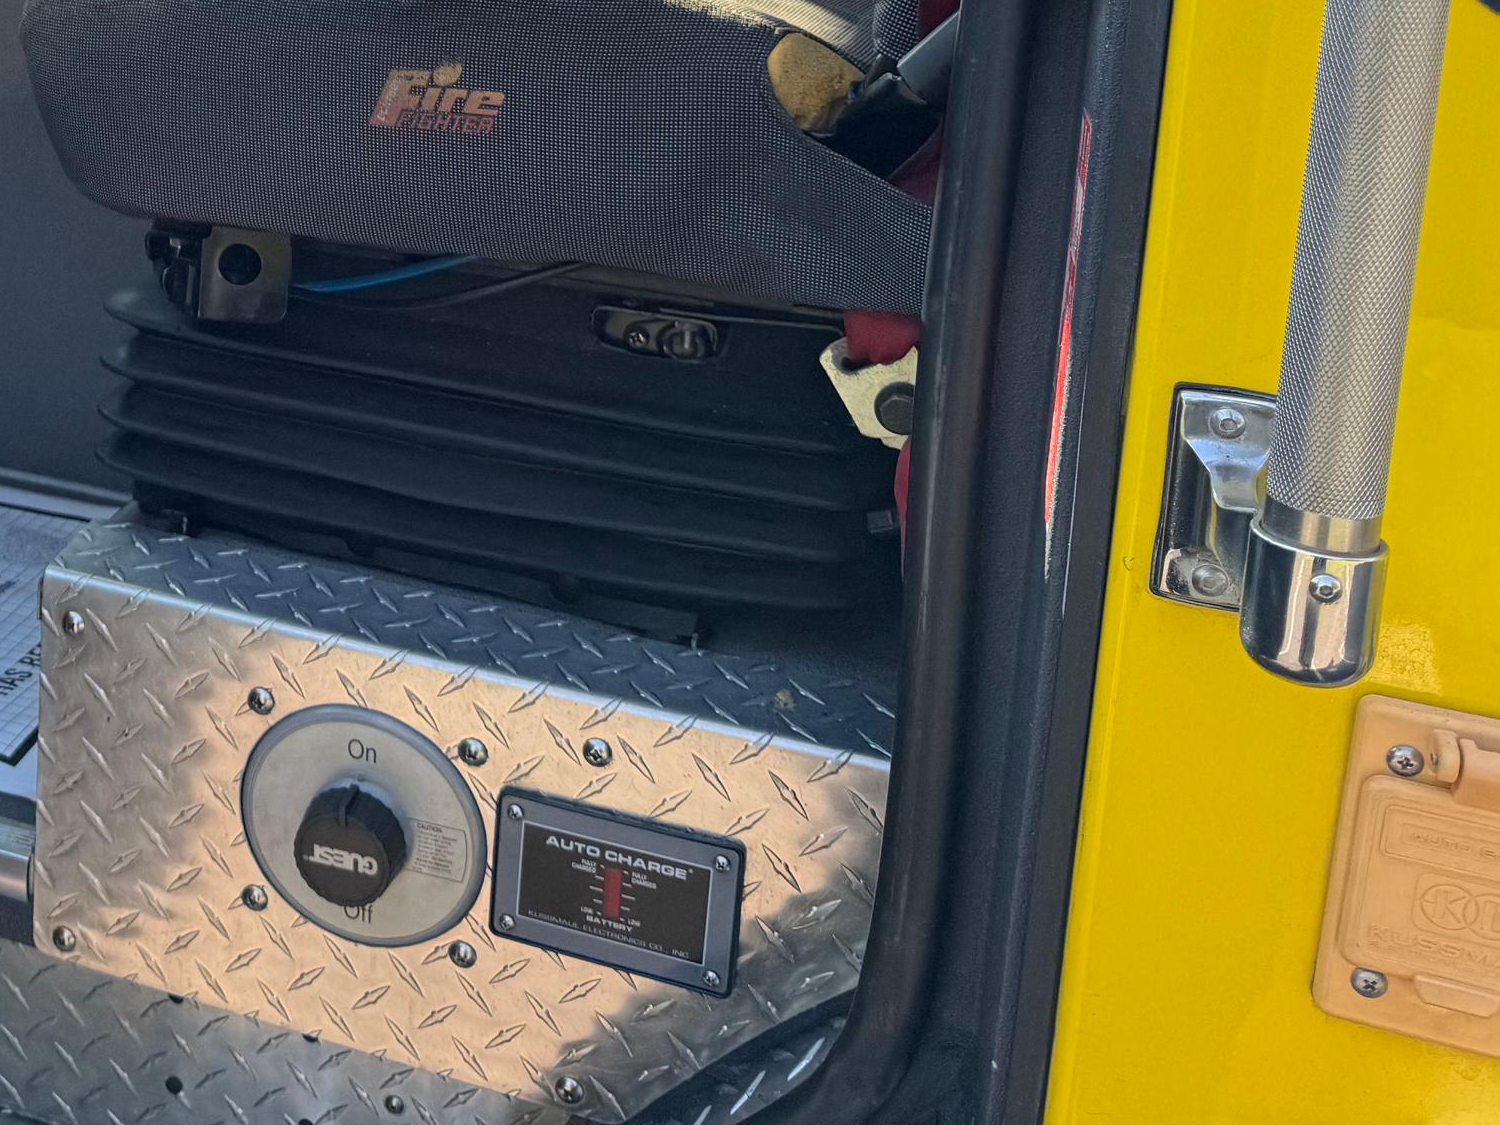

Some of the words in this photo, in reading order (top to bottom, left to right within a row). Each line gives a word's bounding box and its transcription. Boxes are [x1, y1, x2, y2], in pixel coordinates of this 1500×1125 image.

[370, 62, 505, 127] Fire
[347, 738, 377, 763] On
[545, 835, 601, 858] AUTO
[604, 850, 688, 881] CHARGE
[1410, 832, 1471, 852] AUTO
[309, 843, 379, 876] GUEST
[343, 905, 374, 924] Off
[528, 909, 579, 931] KUSSMAUL
[582, 923, 647, 948] ELECTRONICS
[586, 915, 633, 933] BATTERY
[1367, 925, 1500, 970] KUSSM
